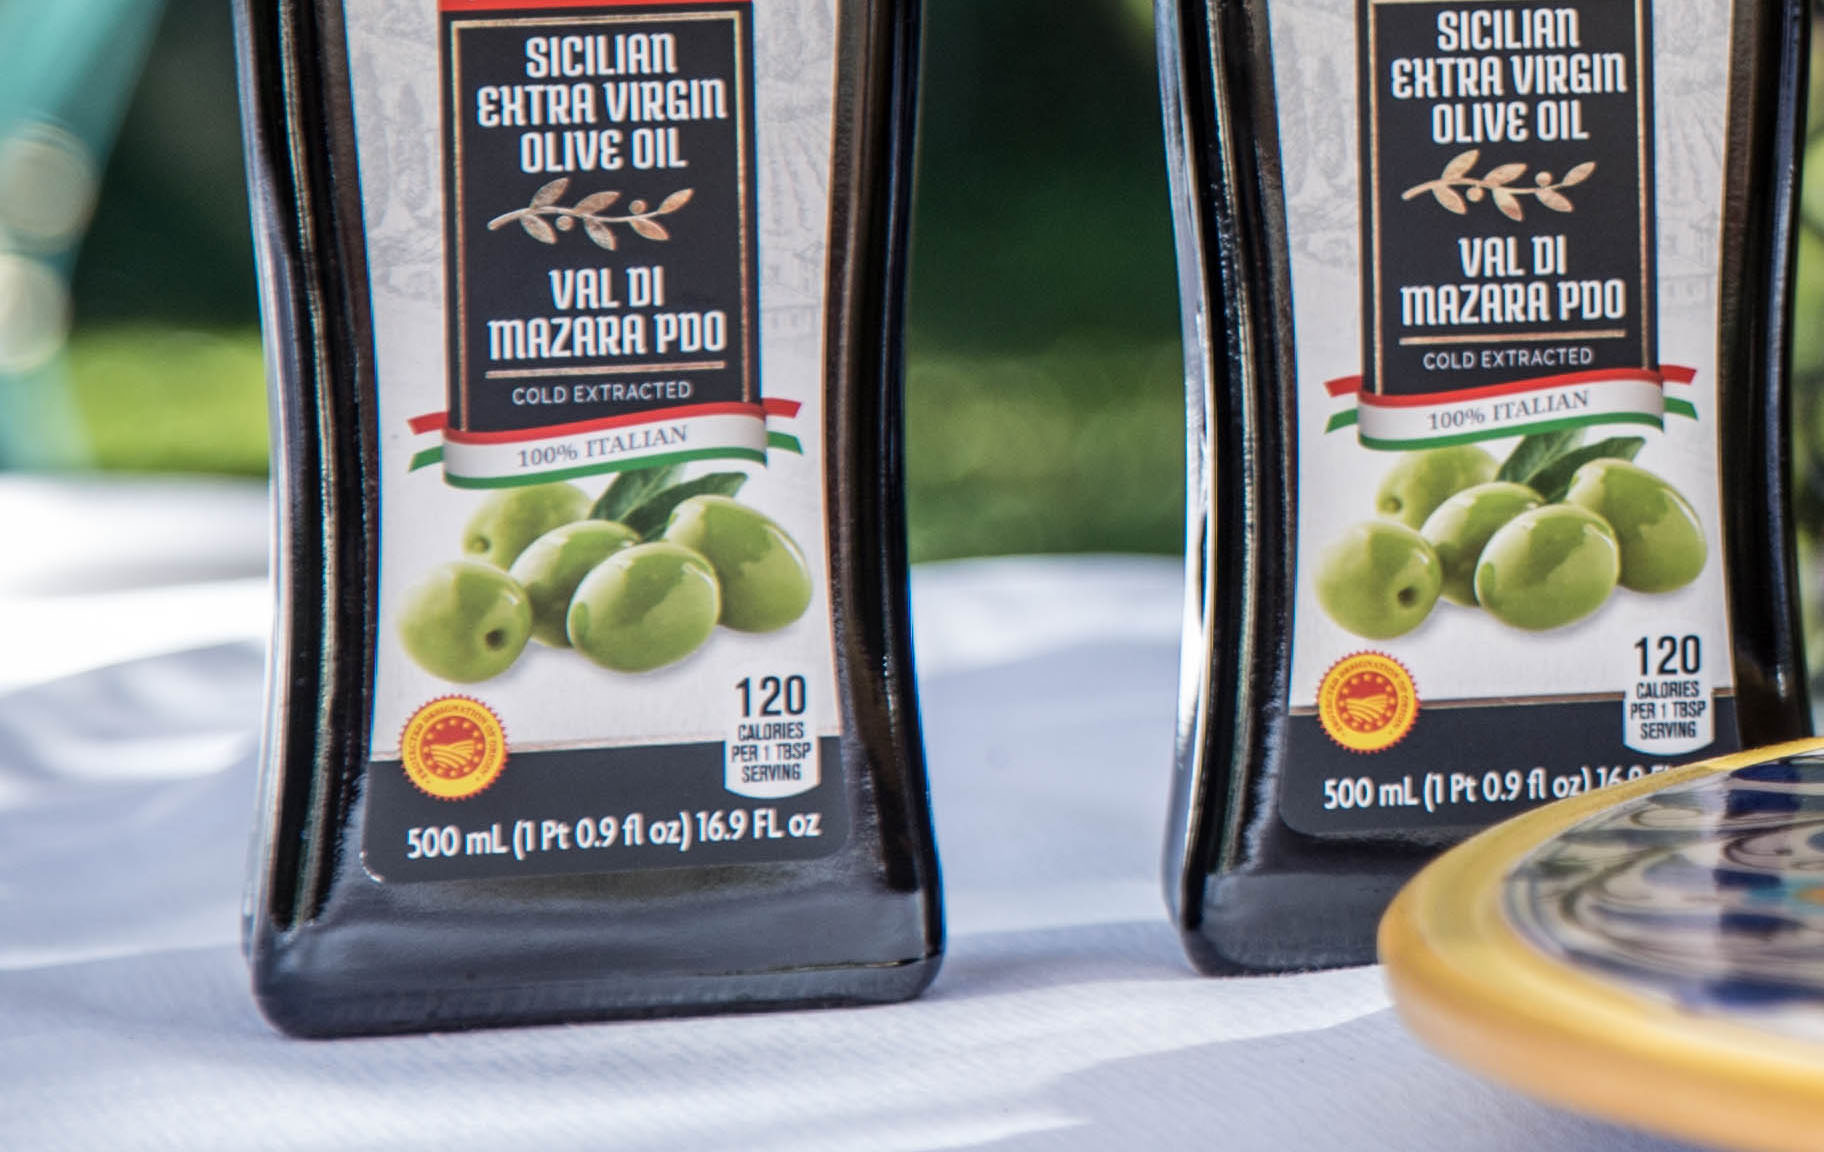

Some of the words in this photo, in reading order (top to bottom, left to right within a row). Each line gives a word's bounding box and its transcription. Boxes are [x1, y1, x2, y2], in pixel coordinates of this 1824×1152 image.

[1437, 7, 1581, 53] SICILIAN
[525, 32, 678, 79] SICILIAN
[1391, 58, 1504, 99] EXTRA
[1510, 52, 1629, 96] VIRGIN
[476, 84, 596, 128] EXTRA
[602, 78, 727, 121] VIRGIN
[1432, 103, 1530, 145] OLIVE
[1537, 100, 1590, 141] OIL
[519, 129, 624, 174] OLIVE
[632, 126, 688, 170] OIL
[1458, 236, 1526, 278] VAL
[1532, 234, 1568, 275] DI
[548, 266, 620, 310] VAL
[626, 265, 665, 308] DI
[1400, 284, 1551, 326] MAZARA
[1557, 278, 1626, 321] PDO
[487, 316, 648, 361] MAZARA
[653, 310, 727, 355] PDO
[1423, 351, 1476, 371] COLD
[1481, 347, 1594, 369] EXTRACTED
[511, 385, 567, 406] COLD
[573, 380, 694, 404] EXTRACTED
[1428, 407, 1486, 432] 100%
[1492, 389, 1590, 423] ITALIAN
[517, 444, 579, 469] 100%
[585, 424, 689, 459] ITALIAN
[1634, 634, 1702, 677] 120
[734, 674, 808, 718] 120
[1630, 702, 1656, 720] PER
[1659, 702, 1667, 719] 1
[1672, 700, 1707, 718] TBSP
[1636, 680, 1701, 700] CALORIES
[731, 744, 757, 763] PER
[761, 744, 770, 762] 1
[775, 742, 812, 761] TBSP
[737, 722, 805, 742] CALORIES
[1640, 721, 1696, 741] SERVING
[741, 764, 802, 784] SERVING
[1322, 778, 1369, 810] 500
[1379, 775, 1419, 807] mL
[1423, 773, 1445, 813] (1
[1450, 772, 1477, 804] Pt
[1483, 771, 1522, 802] 0.9
[1527, 767, 1547, 800] fl
[1552, 765, 1592, 799] oz)
[406, 826, 461, 860] 500
[466, 823, 509, 856] mL
[513, 820, 537, 860] (1
[540, 819, 570, 851] Pt
[575, 817, 619, 848] 0.9
[623, 813, 646, 846] fl
[650, 811, 691, 852] oz)
[697, 809, 748, 842] 16.9
[753, 808, 786, 839] FL
[789, 812, 822, 838] oz
